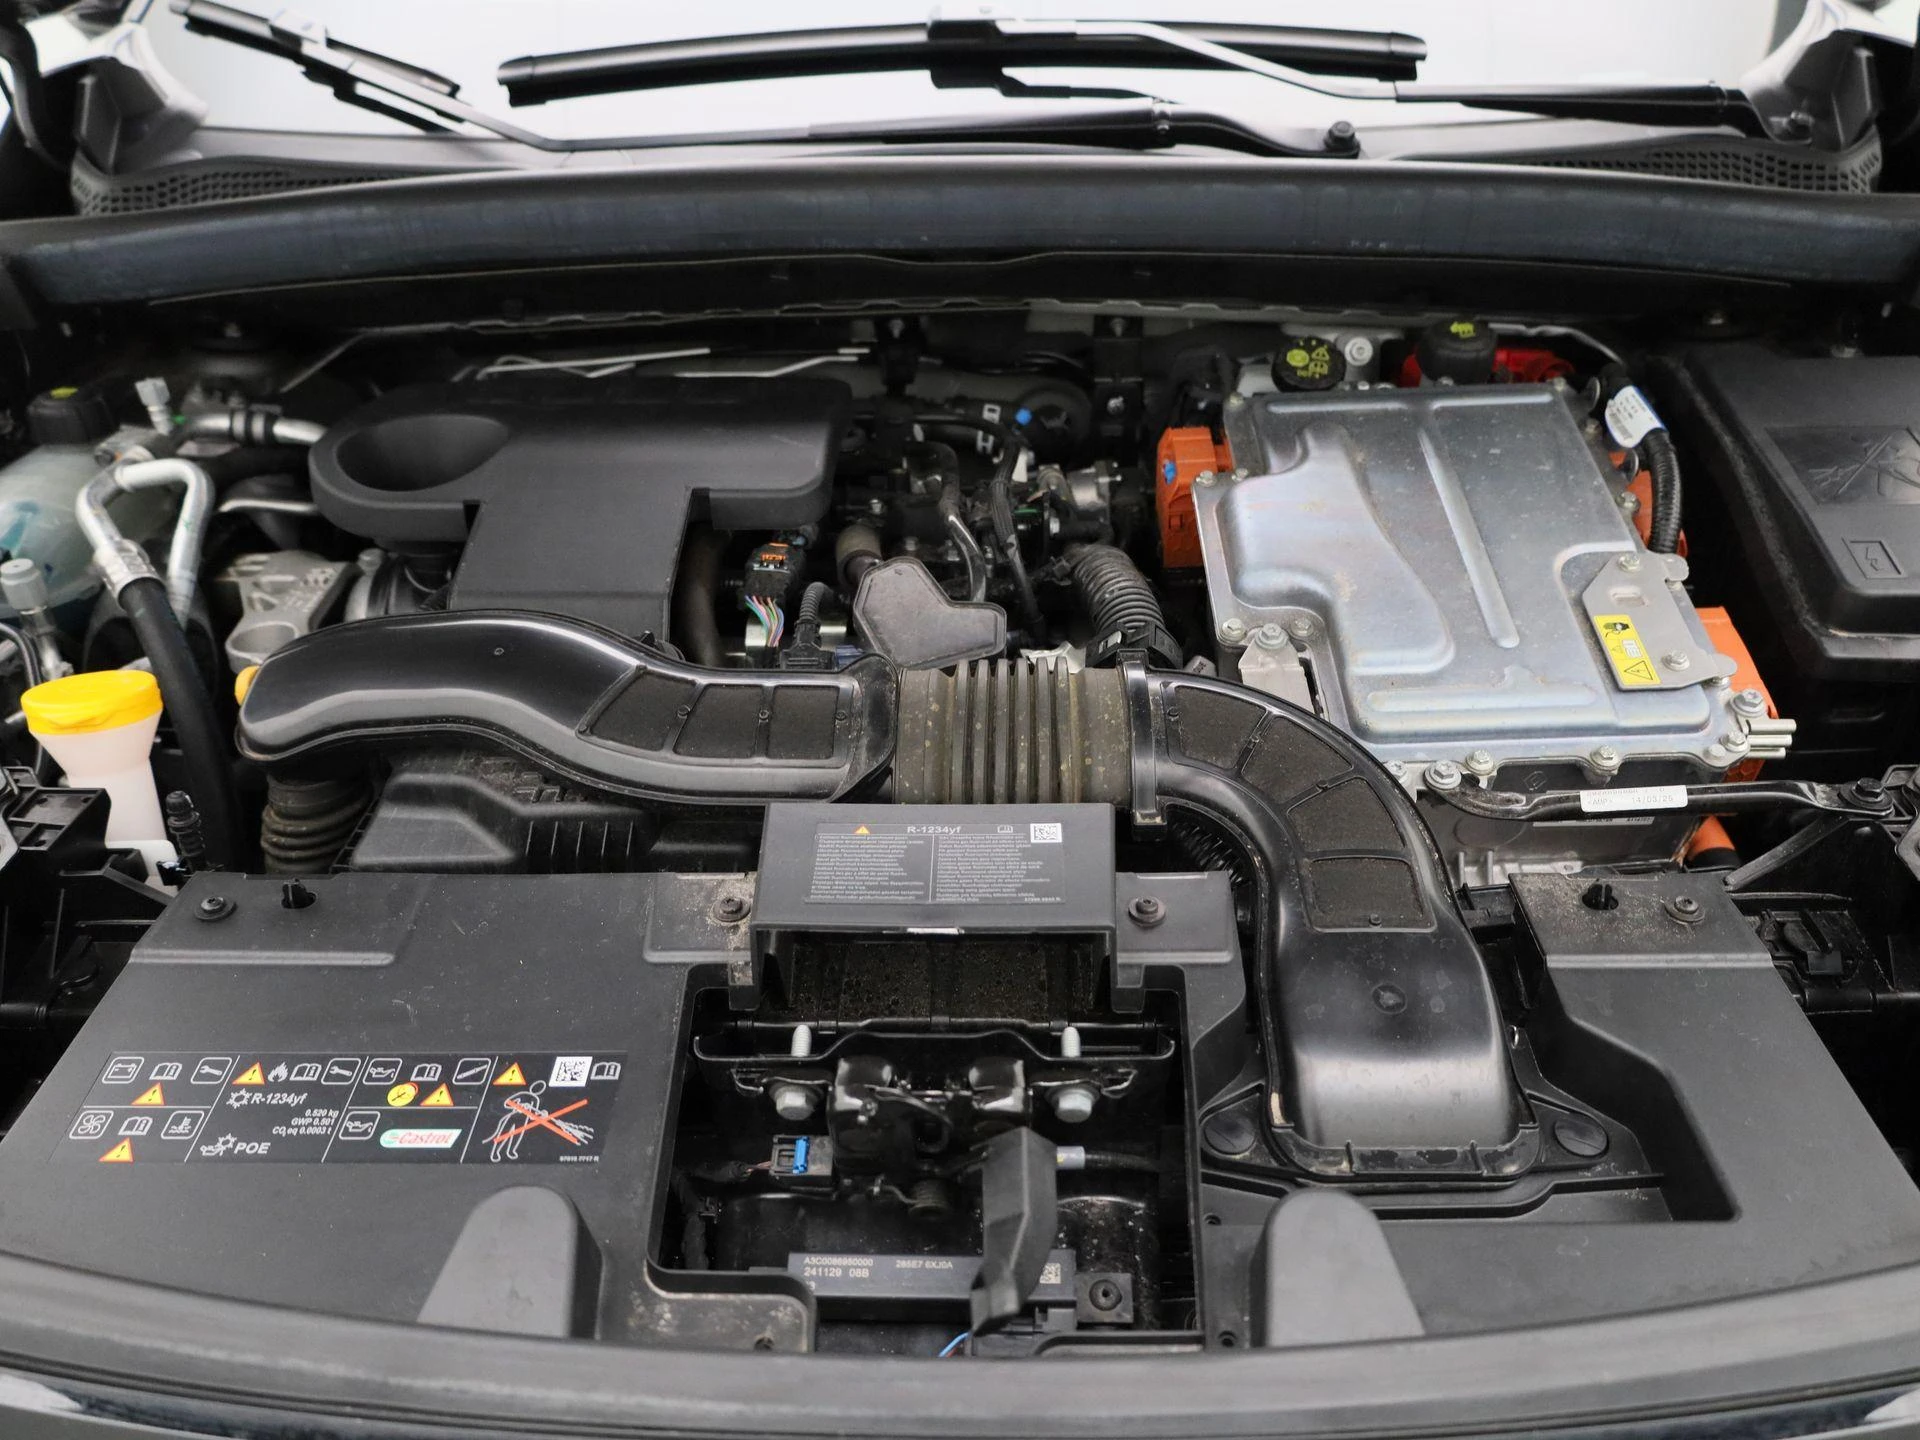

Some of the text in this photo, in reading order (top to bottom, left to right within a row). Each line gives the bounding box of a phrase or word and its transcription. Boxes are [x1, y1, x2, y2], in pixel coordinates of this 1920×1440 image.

[906, 825, 961, 835] R-1234yf
[250, 1092, 308, 1107] R-1234yf
[328, 1109, 340, 1119] kg
[291, 1117, 313, 1126] GWP
[399, 1131, 453, 1145] Castrol
[233, 1142, 271, 1155] POE
